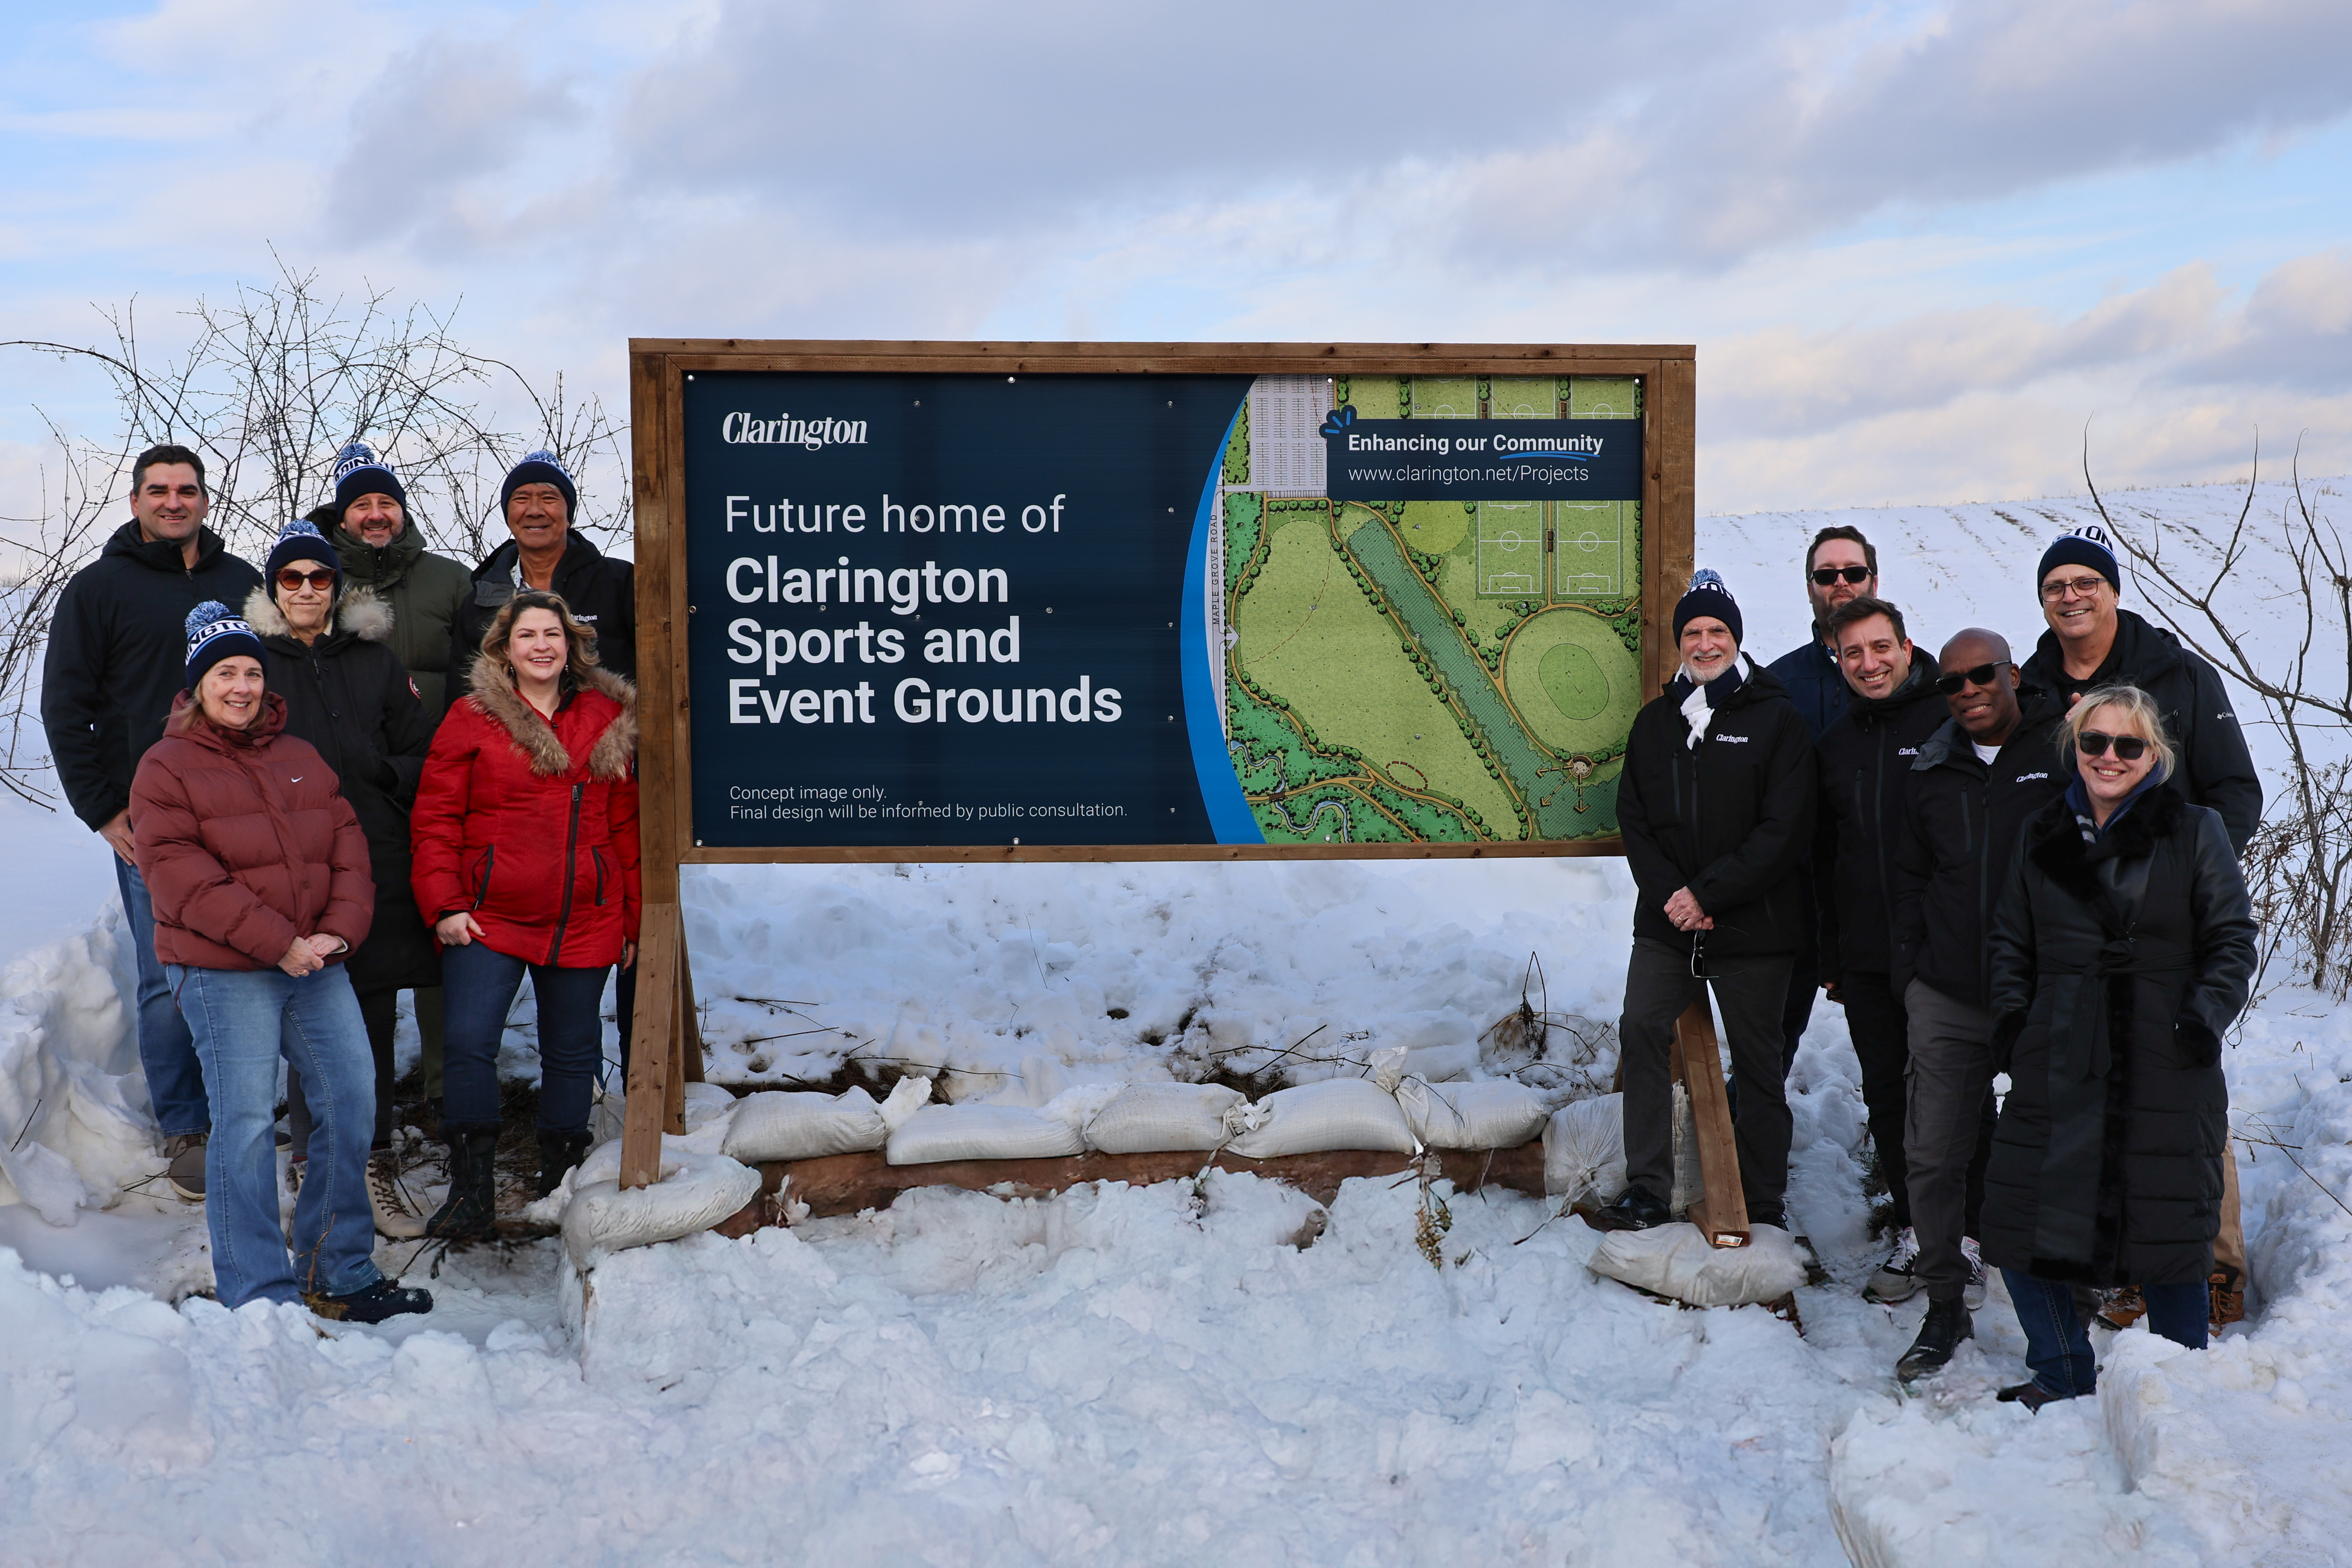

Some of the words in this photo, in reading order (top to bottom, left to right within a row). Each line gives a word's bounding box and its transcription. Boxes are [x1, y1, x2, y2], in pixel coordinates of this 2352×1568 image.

[722, 412, 868, 451] Clarington
[1349, 433, 1449, 455] Enhancing
[1456, 438, 1487, 451] our
[1493, 434, 1604, 455] Community
[1348, 464, 1589, 485] www.clarington.net/Projects
[726, 496, 866, 532] Future
[883, 494, 1005, 532] home
[1021, 494, 1066, 532] of
[726, 555, 1008, 615] Clarington
[571, 614, 598, 622] larington
[727, 618, 905, 675] Sports
[923, 616, 1020, 663] and
[729, 678, 875, 724] Event
[894, 675, 1122, 723] Grounds
[1716, 734, 1748, 744] Clarington
[2016, 772, 2048, 783] Clarington
[730, 786, 795, 802] Concept
[800, 786, 848, 802] image
[852, 784, 887, 802] only.
[731, 805, 767, 819] Final
[772, 805, 823, 822] design
[828, 804, 853, 818] will
[859, 804, 877, 818] be
[882, 804, 950, 818] informed
[957, 804, 974, 821] by
[979, 803, 1024, 820] public
[1029, 803, 1128, 817] consultation.
